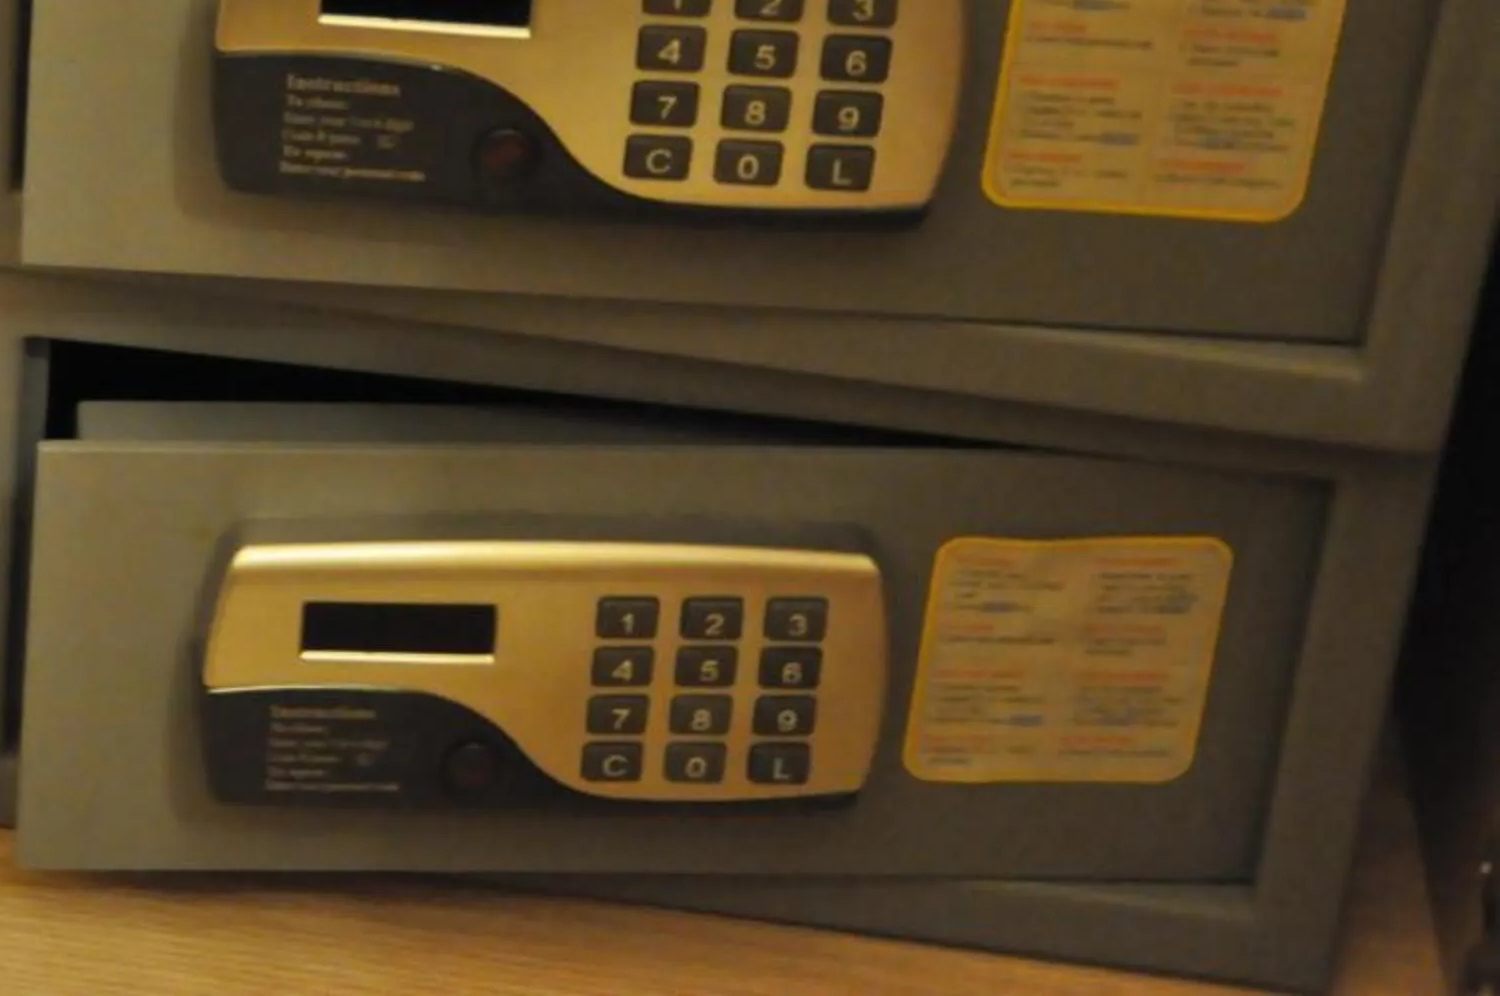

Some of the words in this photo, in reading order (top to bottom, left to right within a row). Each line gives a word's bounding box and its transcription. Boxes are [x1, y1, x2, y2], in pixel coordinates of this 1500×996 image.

[657, 38, 681, 65] 4
[753, 43, 777, 71] 5
[844, 49, 867, 77] 6
[656, 94, 678, 121] 7
[743, 99, 767, 127] 8
[836, 105, 860, 132] 9
[644, 147, 674, 175] C
[736, 153, 760, 181] 0
[831, 157, 853, 187] L
[620, 612, 635, 634] 1
[703, 612, 725, 637] 2
[788, 613, 809, 637] 3
[610, 659, 633, 682] 4
[699, 659, 721, 683] 5
[781, 660, 803, 685] 6
[610, 707, 632, 731] 7
[690, 708, 712, 732] 8
[776, 708, 799, 733] 9
[602, 754, 630, 778] C
[683, 755, 707, 780] 0
[772, 756, 792, 782] L
